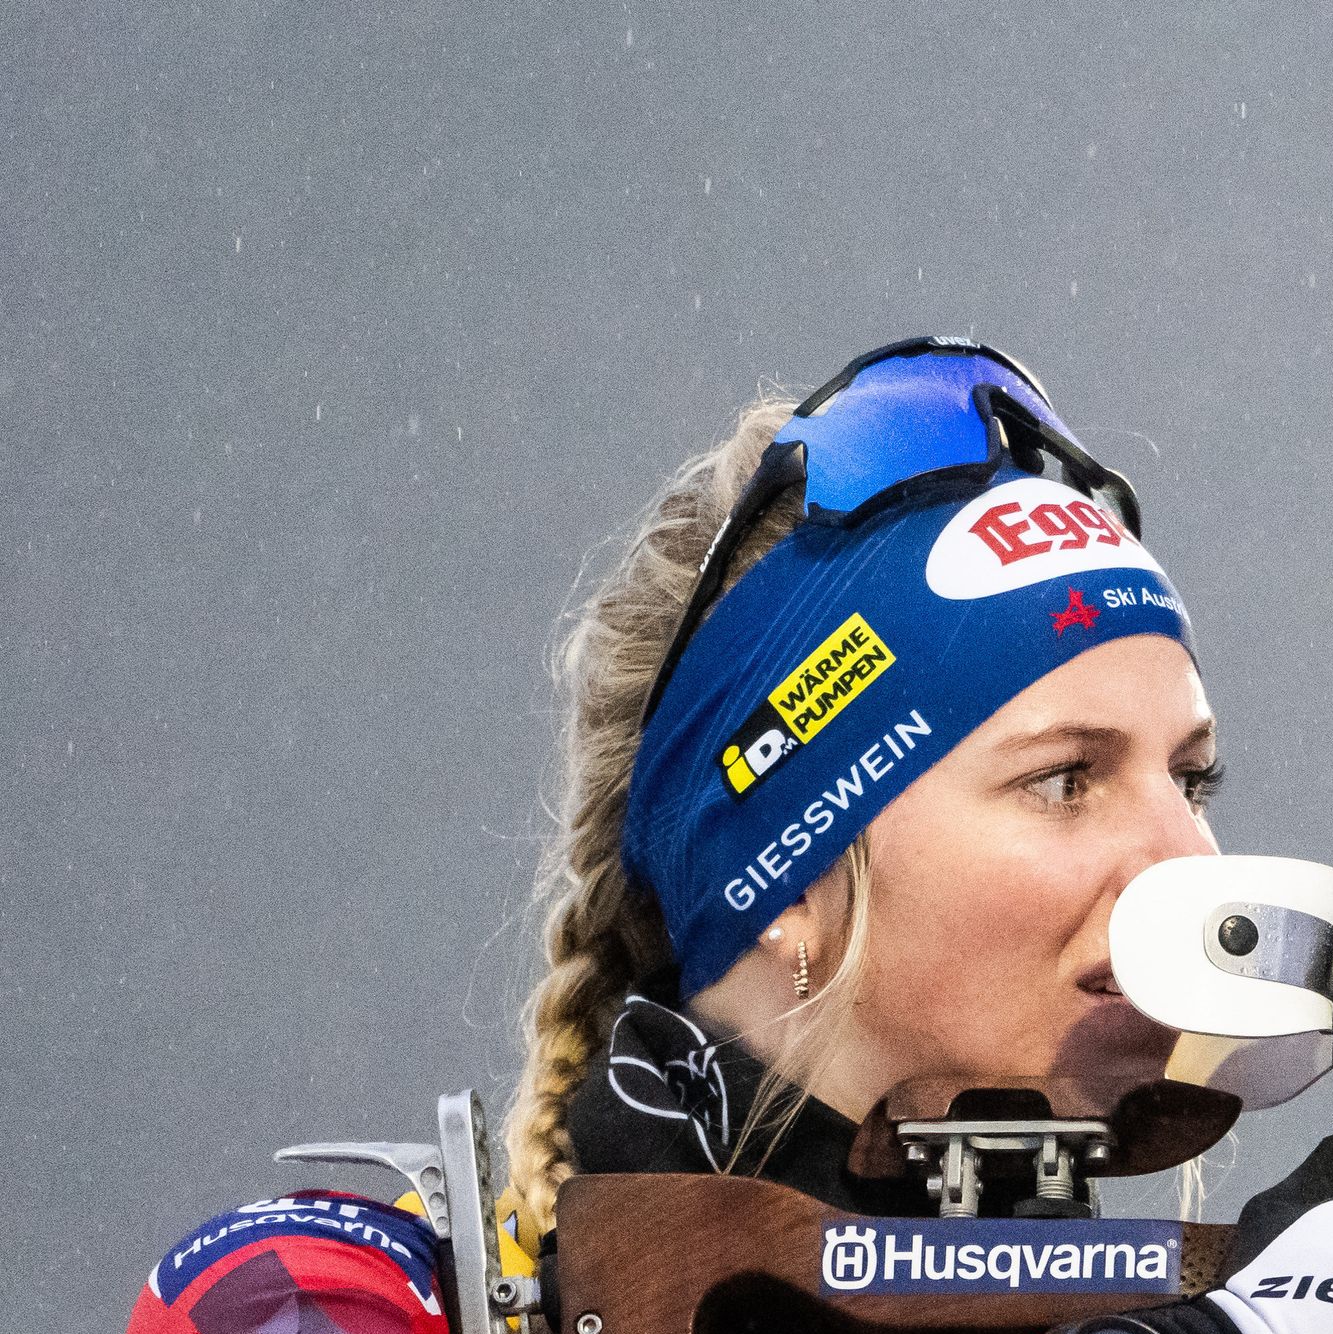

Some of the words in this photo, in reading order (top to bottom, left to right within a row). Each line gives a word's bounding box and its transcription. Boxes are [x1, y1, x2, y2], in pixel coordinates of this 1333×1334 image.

[968, 501, 1139, 566] Egg
[1103, 587, 1137, 608] Ski
[1142, 588, 1192, 628] Aust
[778, 625, 870, 712] WÄRME
[792, 644, 888, 735] PUMPEN
[723, 708, 933, 912] GIESSWEIN
[174, 1212, 412, 1269] Husqvarna
[883, 1234, 1169, 1288] Husqvarna
